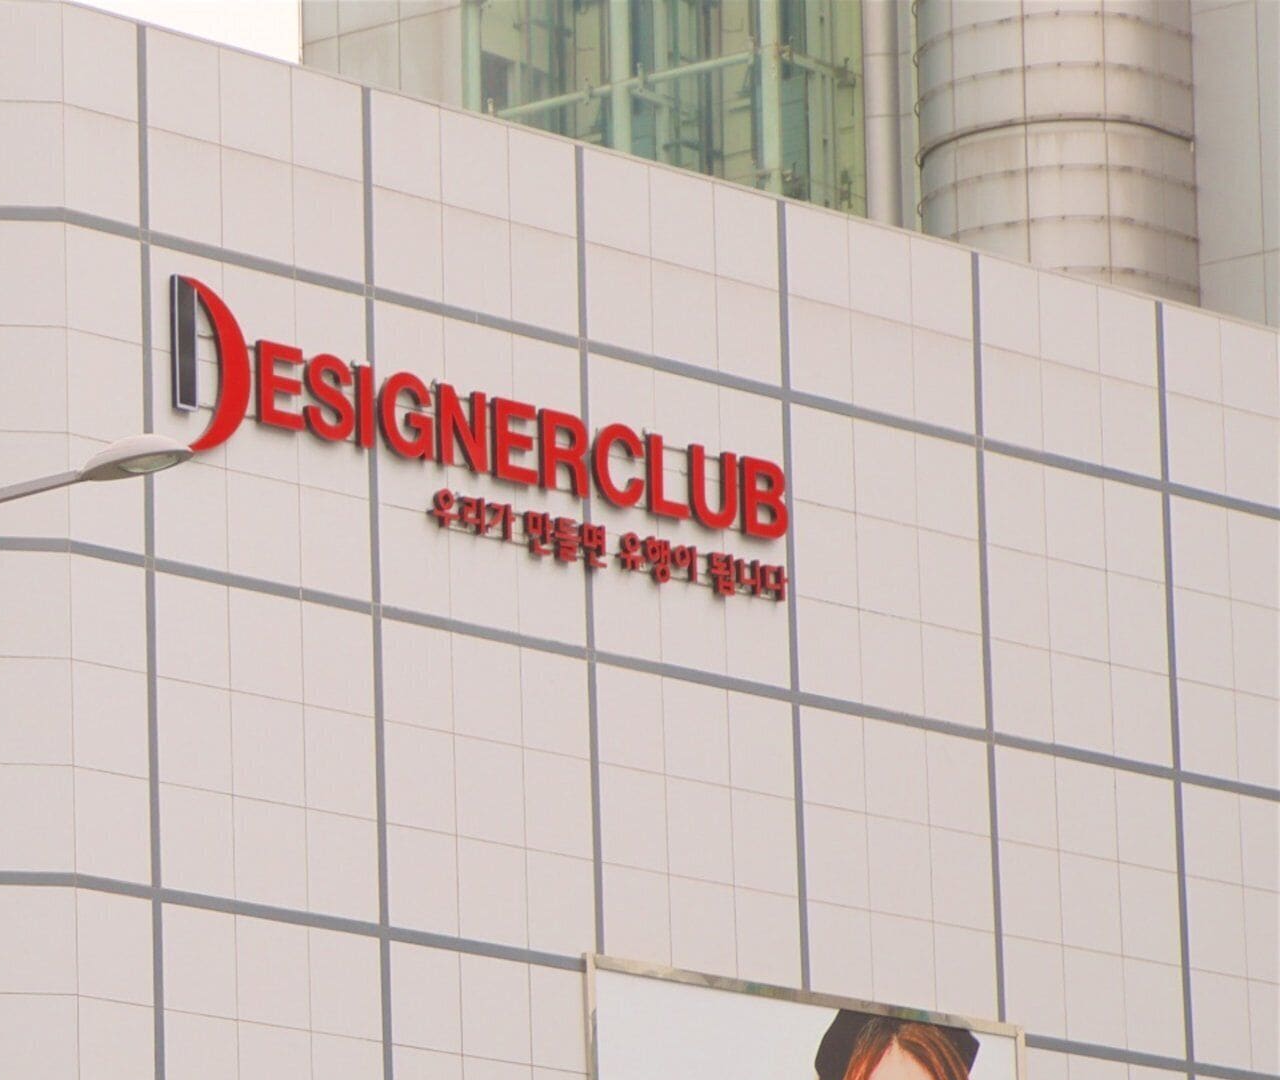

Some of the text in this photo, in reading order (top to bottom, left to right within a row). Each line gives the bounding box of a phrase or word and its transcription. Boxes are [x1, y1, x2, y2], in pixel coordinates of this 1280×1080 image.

[432, 488, 789, 602] 우리가 만들면 유행이 됩니다
